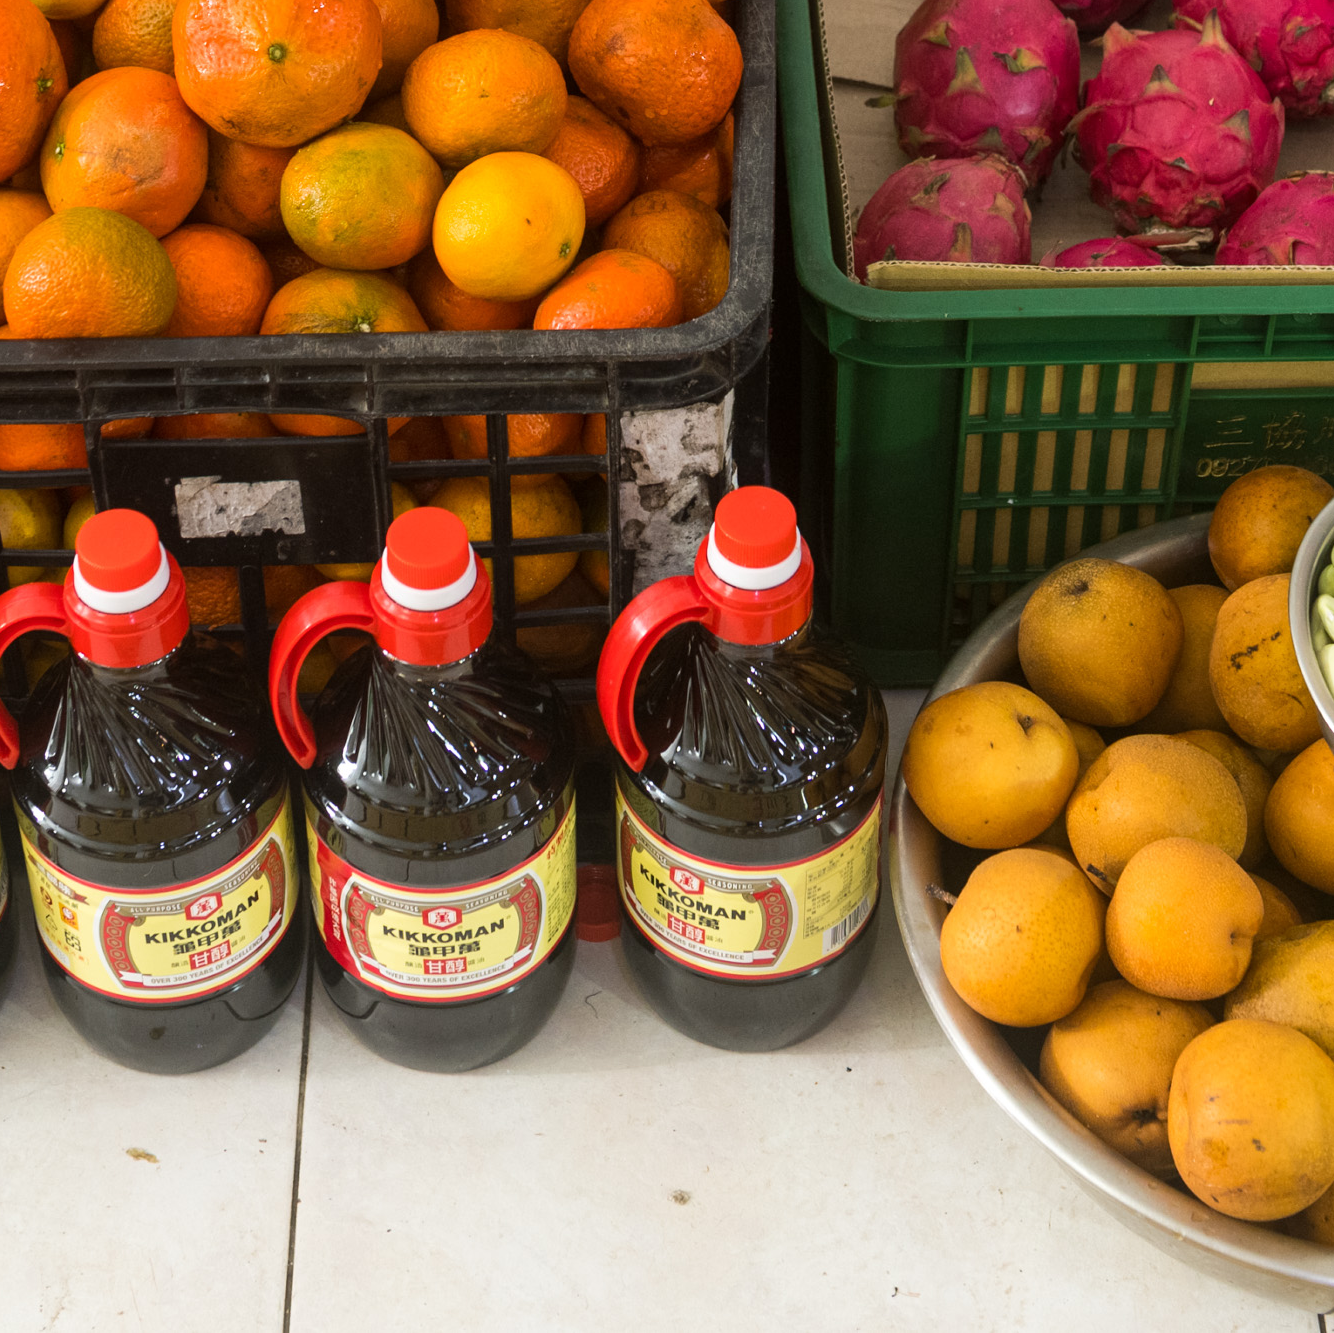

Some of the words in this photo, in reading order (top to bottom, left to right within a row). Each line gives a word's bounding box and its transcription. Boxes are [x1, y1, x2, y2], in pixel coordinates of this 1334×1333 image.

[224, 860, 258, 890] SEASONING
[707, 877, 753, 890] SEASONING
[465, 889, 508, 909] SEASONING
[640, 862, 746, 921] KIKKOMAN
[144, 889, 260, 944] KIKKOMAN
[382, 918, 505, 944] KIKKOMAN
[669, 917, 704, 944] 甘醇
[191, 942, 231, 969] 甘醇
[666, 929, 687, 947] YEARS
[688, 941, 697, 950] OF
[698, 945, 745, 961] EXCELLENCE
[150, 977, 171, 985] OVER
[189, 969, 214, 980] YEARS
[215, 963, 225, 972] OF
[226, 934, 265, 965] EXCELLENCE
[425, 959, 466, 974] 甘醇
[405, 975, 421, 983] 300
[449, 975, 459, 983] OF
[460, 964, 506, 982] EXCELLENCE
